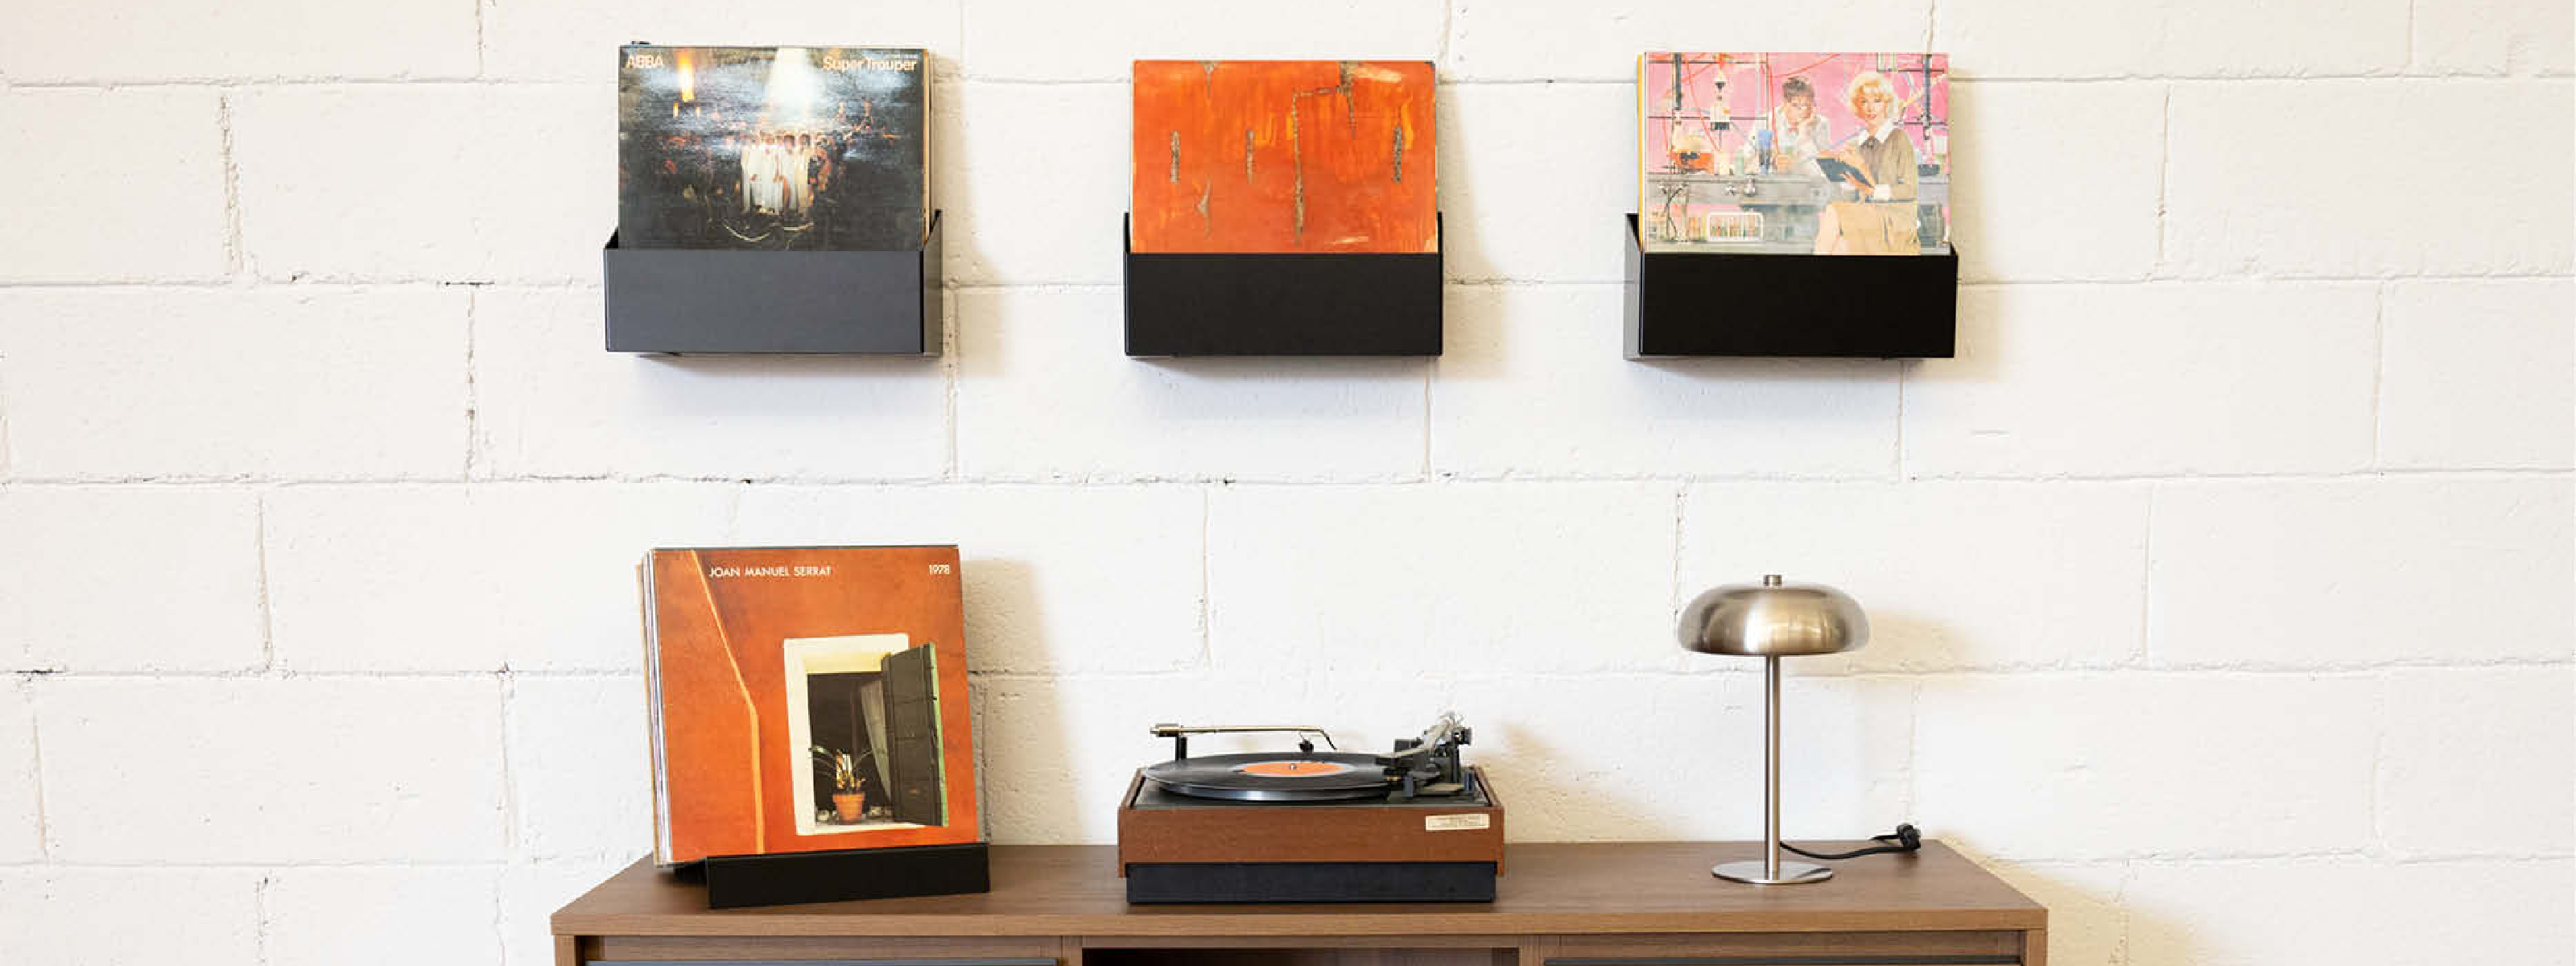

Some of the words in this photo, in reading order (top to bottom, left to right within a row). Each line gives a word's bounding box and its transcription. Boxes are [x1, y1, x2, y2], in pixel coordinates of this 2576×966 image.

[626, 55, 663, 68] ABBA
[823, 56, 862, 72] Super
[865, 57, 917, 72] Trouper
[709, 566, 740, 577] JOAN
[745, 565, 790, 576] MANUEL
[794, 565, 832, 576] SERRAT
[928, 564, 949, 574] 1978
